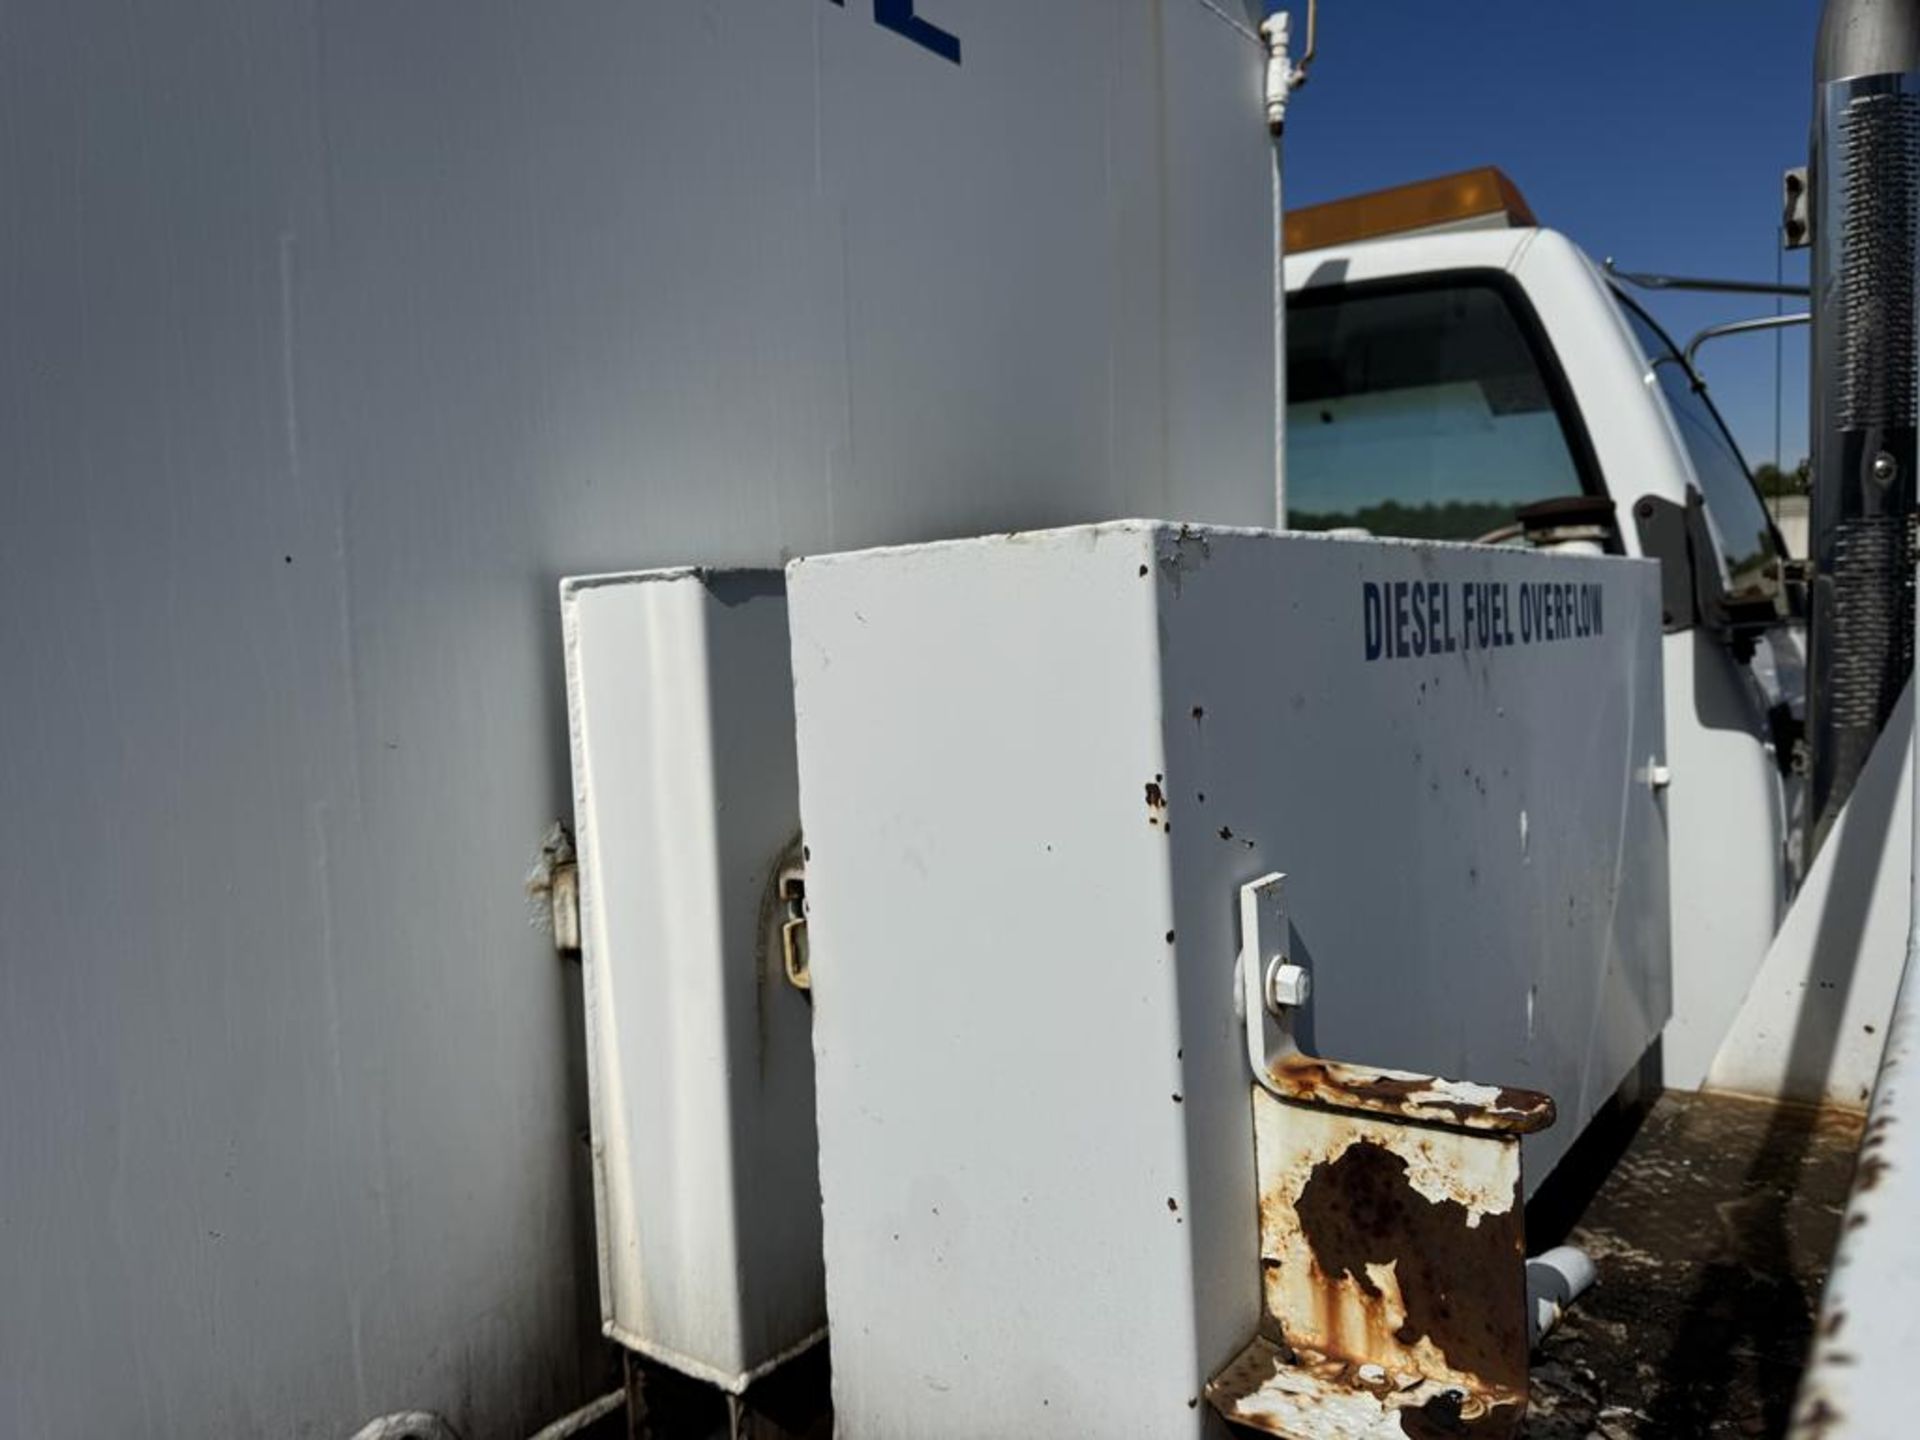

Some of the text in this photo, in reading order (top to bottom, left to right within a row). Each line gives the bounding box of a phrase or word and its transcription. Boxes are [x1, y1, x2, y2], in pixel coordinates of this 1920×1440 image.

[1363, 581, 1604, 661] DIESEL FUEL OVERFLOW
